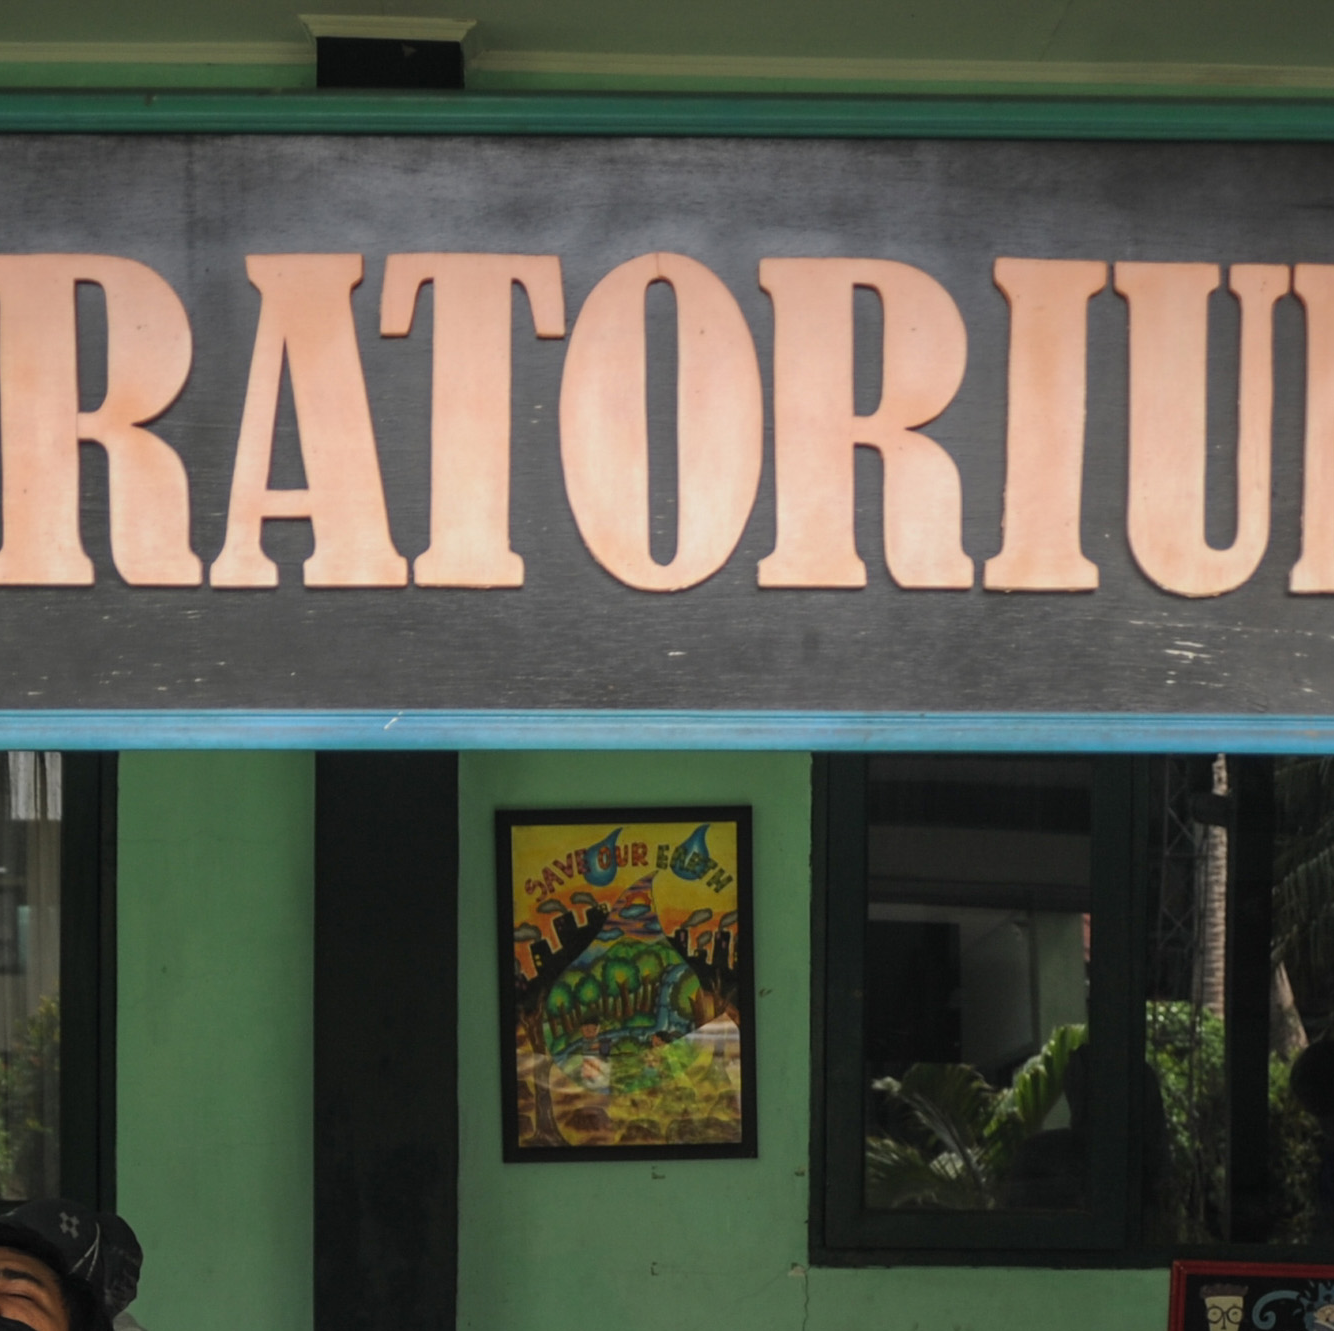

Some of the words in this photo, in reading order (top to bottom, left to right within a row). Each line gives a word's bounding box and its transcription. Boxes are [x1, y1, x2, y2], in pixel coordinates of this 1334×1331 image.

[524, 845, 589, 902] SAVE
[598, 842, 648, 868] OUR
[656, 843, 733, 893] EARTH
